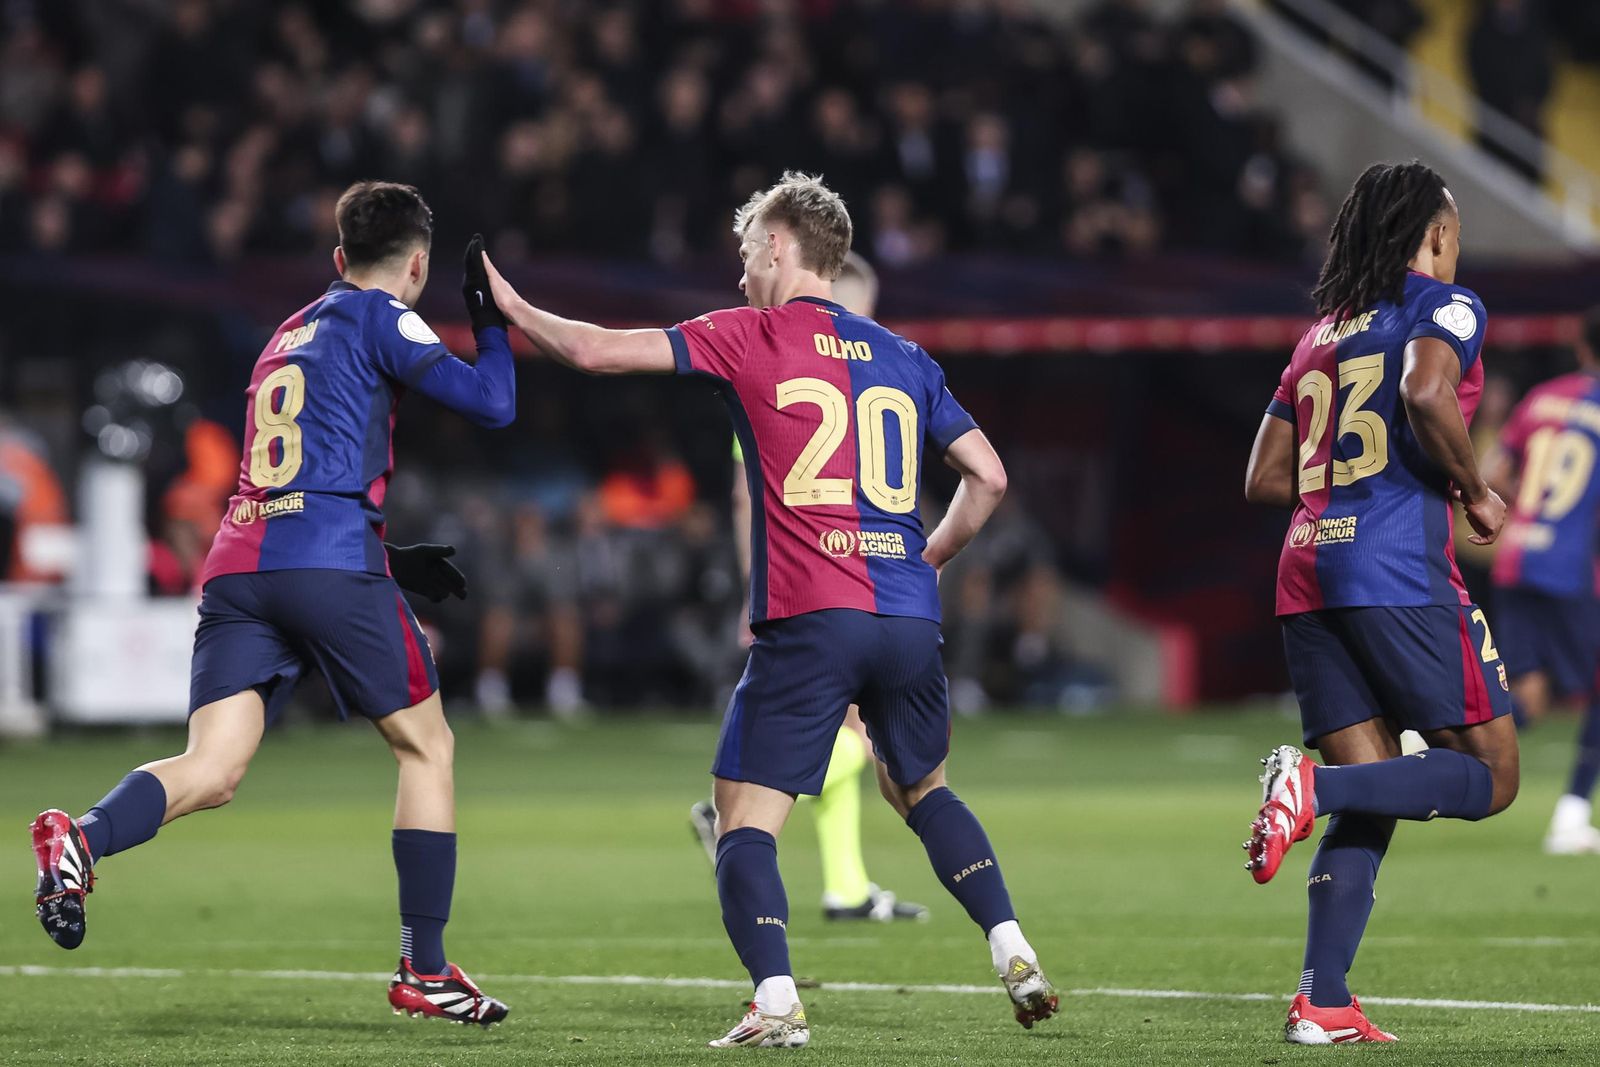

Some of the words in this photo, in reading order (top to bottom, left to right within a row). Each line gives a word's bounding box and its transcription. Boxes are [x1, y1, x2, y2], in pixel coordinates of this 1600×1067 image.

[274, 319, 319, 353] PEDRI
[1312, 310, 1379, 349] KOUNDE
[813, 333, 873, 361] OLMO
[249, 364, 305, 488] 8
[1296, 352, 1389, 494] 23
[776, 377, 919, 514] 20
[1517, 432, 1596, 522] 19
[258, 497, 304, 517] ACNUR
[856, 530, 904, 545] UNHCR
[1313, 527, 1356, 542] ACNUR
[1315, 516, 1357, 530] UNHCR
[858, 541, 907, 555] ACNUR
